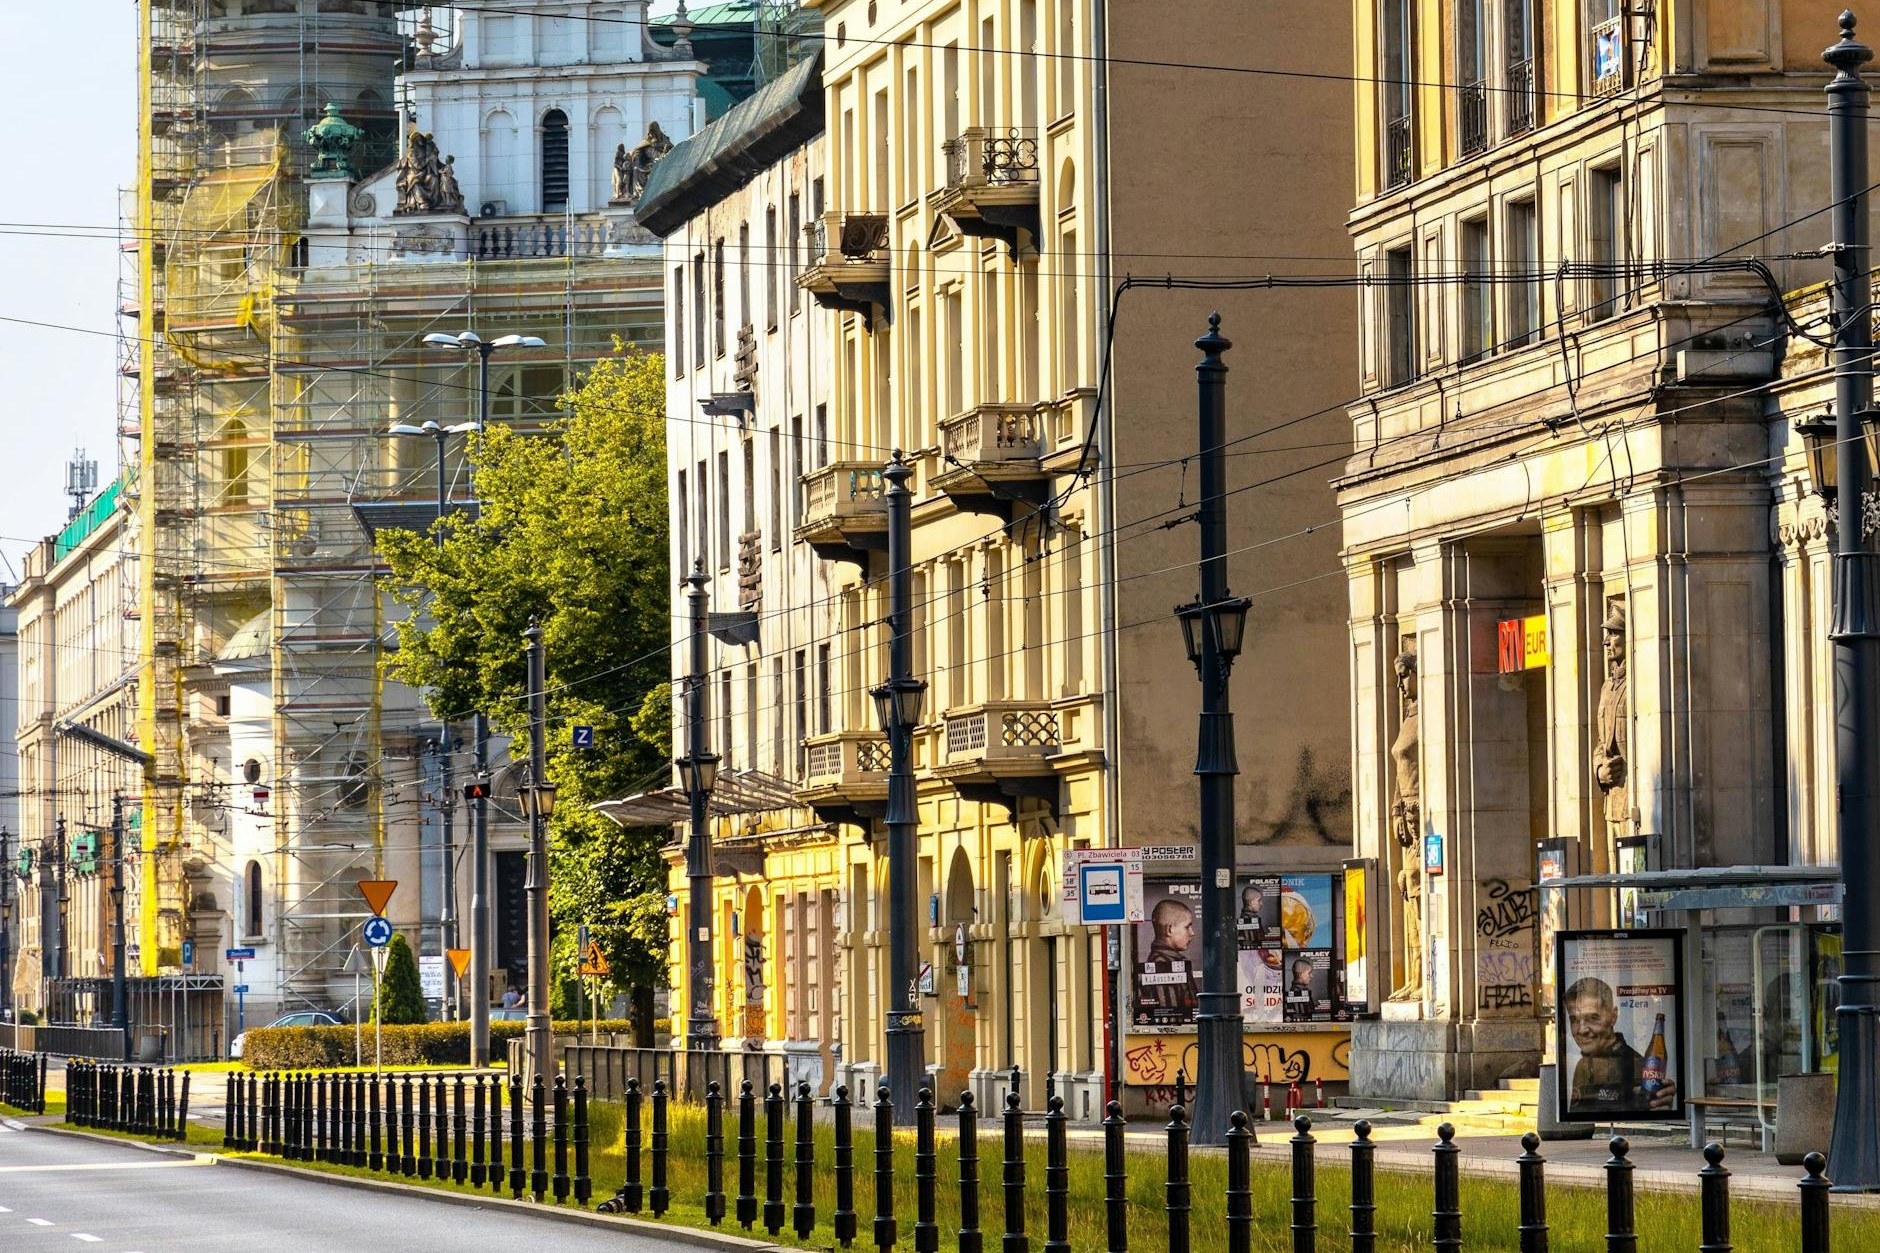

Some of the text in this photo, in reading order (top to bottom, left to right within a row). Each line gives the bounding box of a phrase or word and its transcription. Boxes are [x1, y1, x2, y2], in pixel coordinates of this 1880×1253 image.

[1498, 618, 1525, 674] RTV
[577, 729, 588, 744] Z
[1077, 851, 1086, 859] Pl.
[1088, 851, 1127, 859] Zbawiciela
[1066, 865, 1073, 873] 4
[1168, 884, 1202, 895] POL
[1658, 986, 1668, 994] TY
[1629, 999, 1649, 1008] Zera
